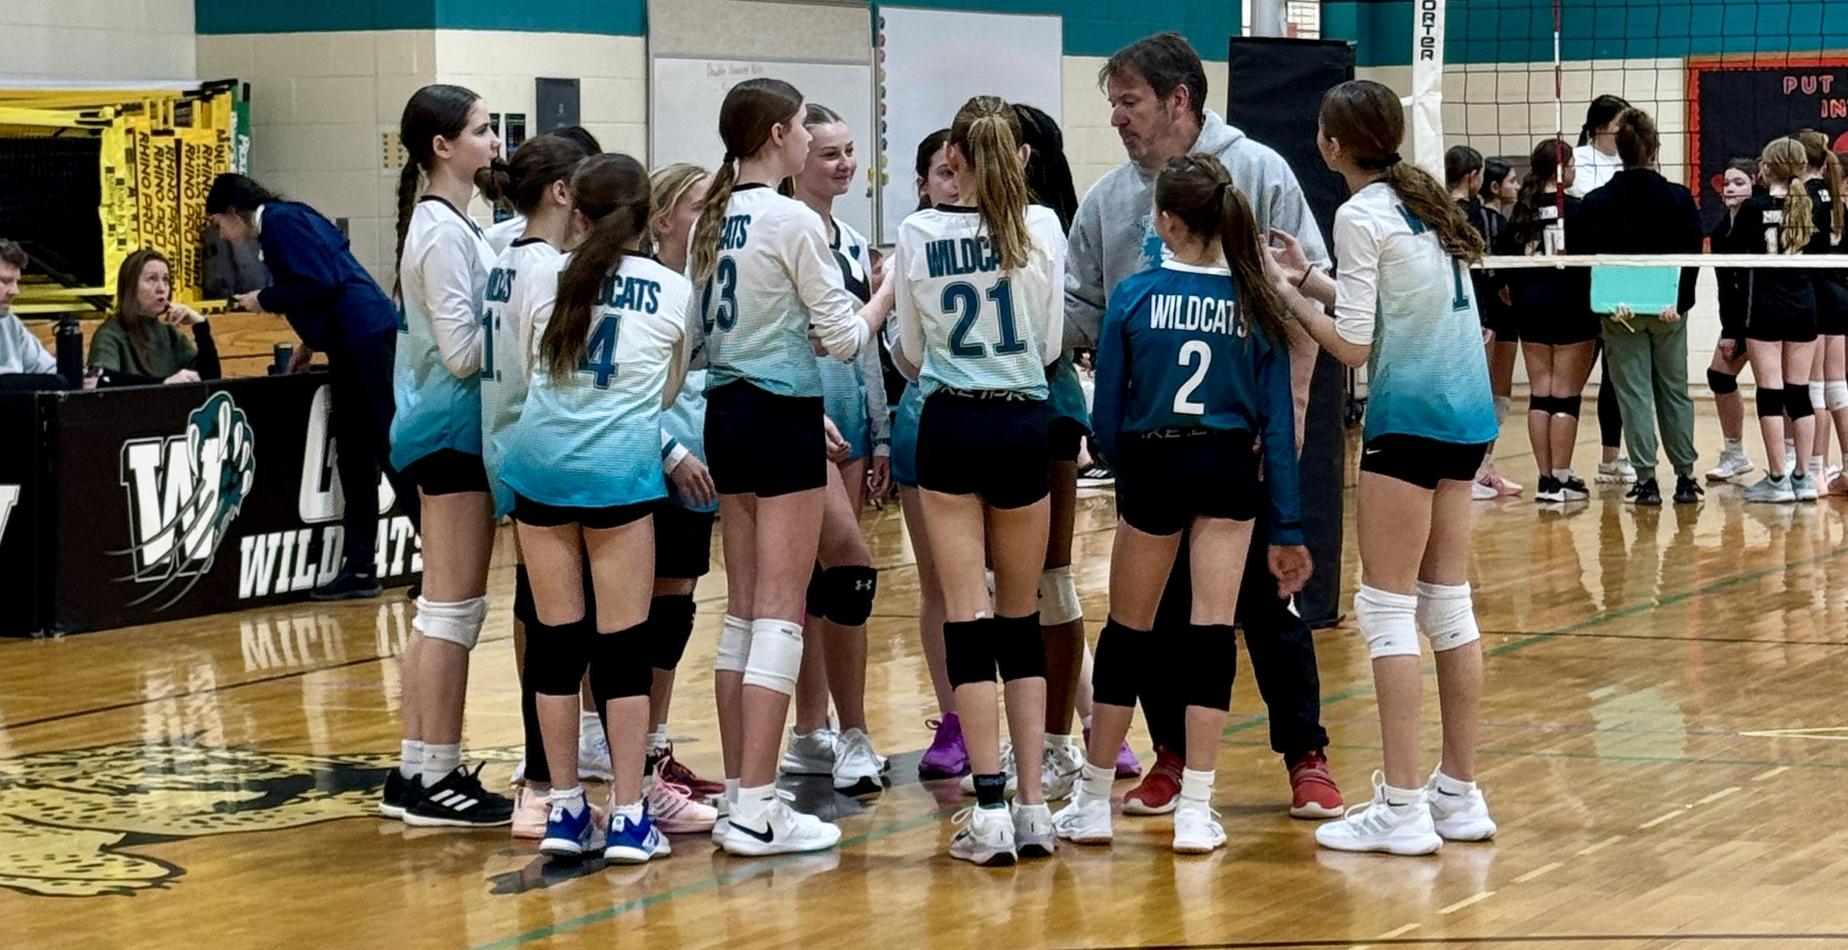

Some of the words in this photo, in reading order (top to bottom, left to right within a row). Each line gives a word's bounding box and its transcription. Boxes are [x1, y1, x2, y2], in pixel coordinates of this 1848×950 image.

[1783, 75, 1834, 95] PUT
[1821, 98, 1848, 118] IN
[139, 131, 152, 190] RHINO
[153, 145, 166, 203] RHINO
[165, 144, 176, 202] RHINO
[184, 142, 196, 201] RHINO
[142, 192, 154, 235] PRO
[184, 202, 195, 245] PRO
[940, 277, 1028, 358] 21
[578, 312, 622, 390] 4
[1173, 339, 1212, 415] 2
[239, 515, 424, 599] WILDAT
